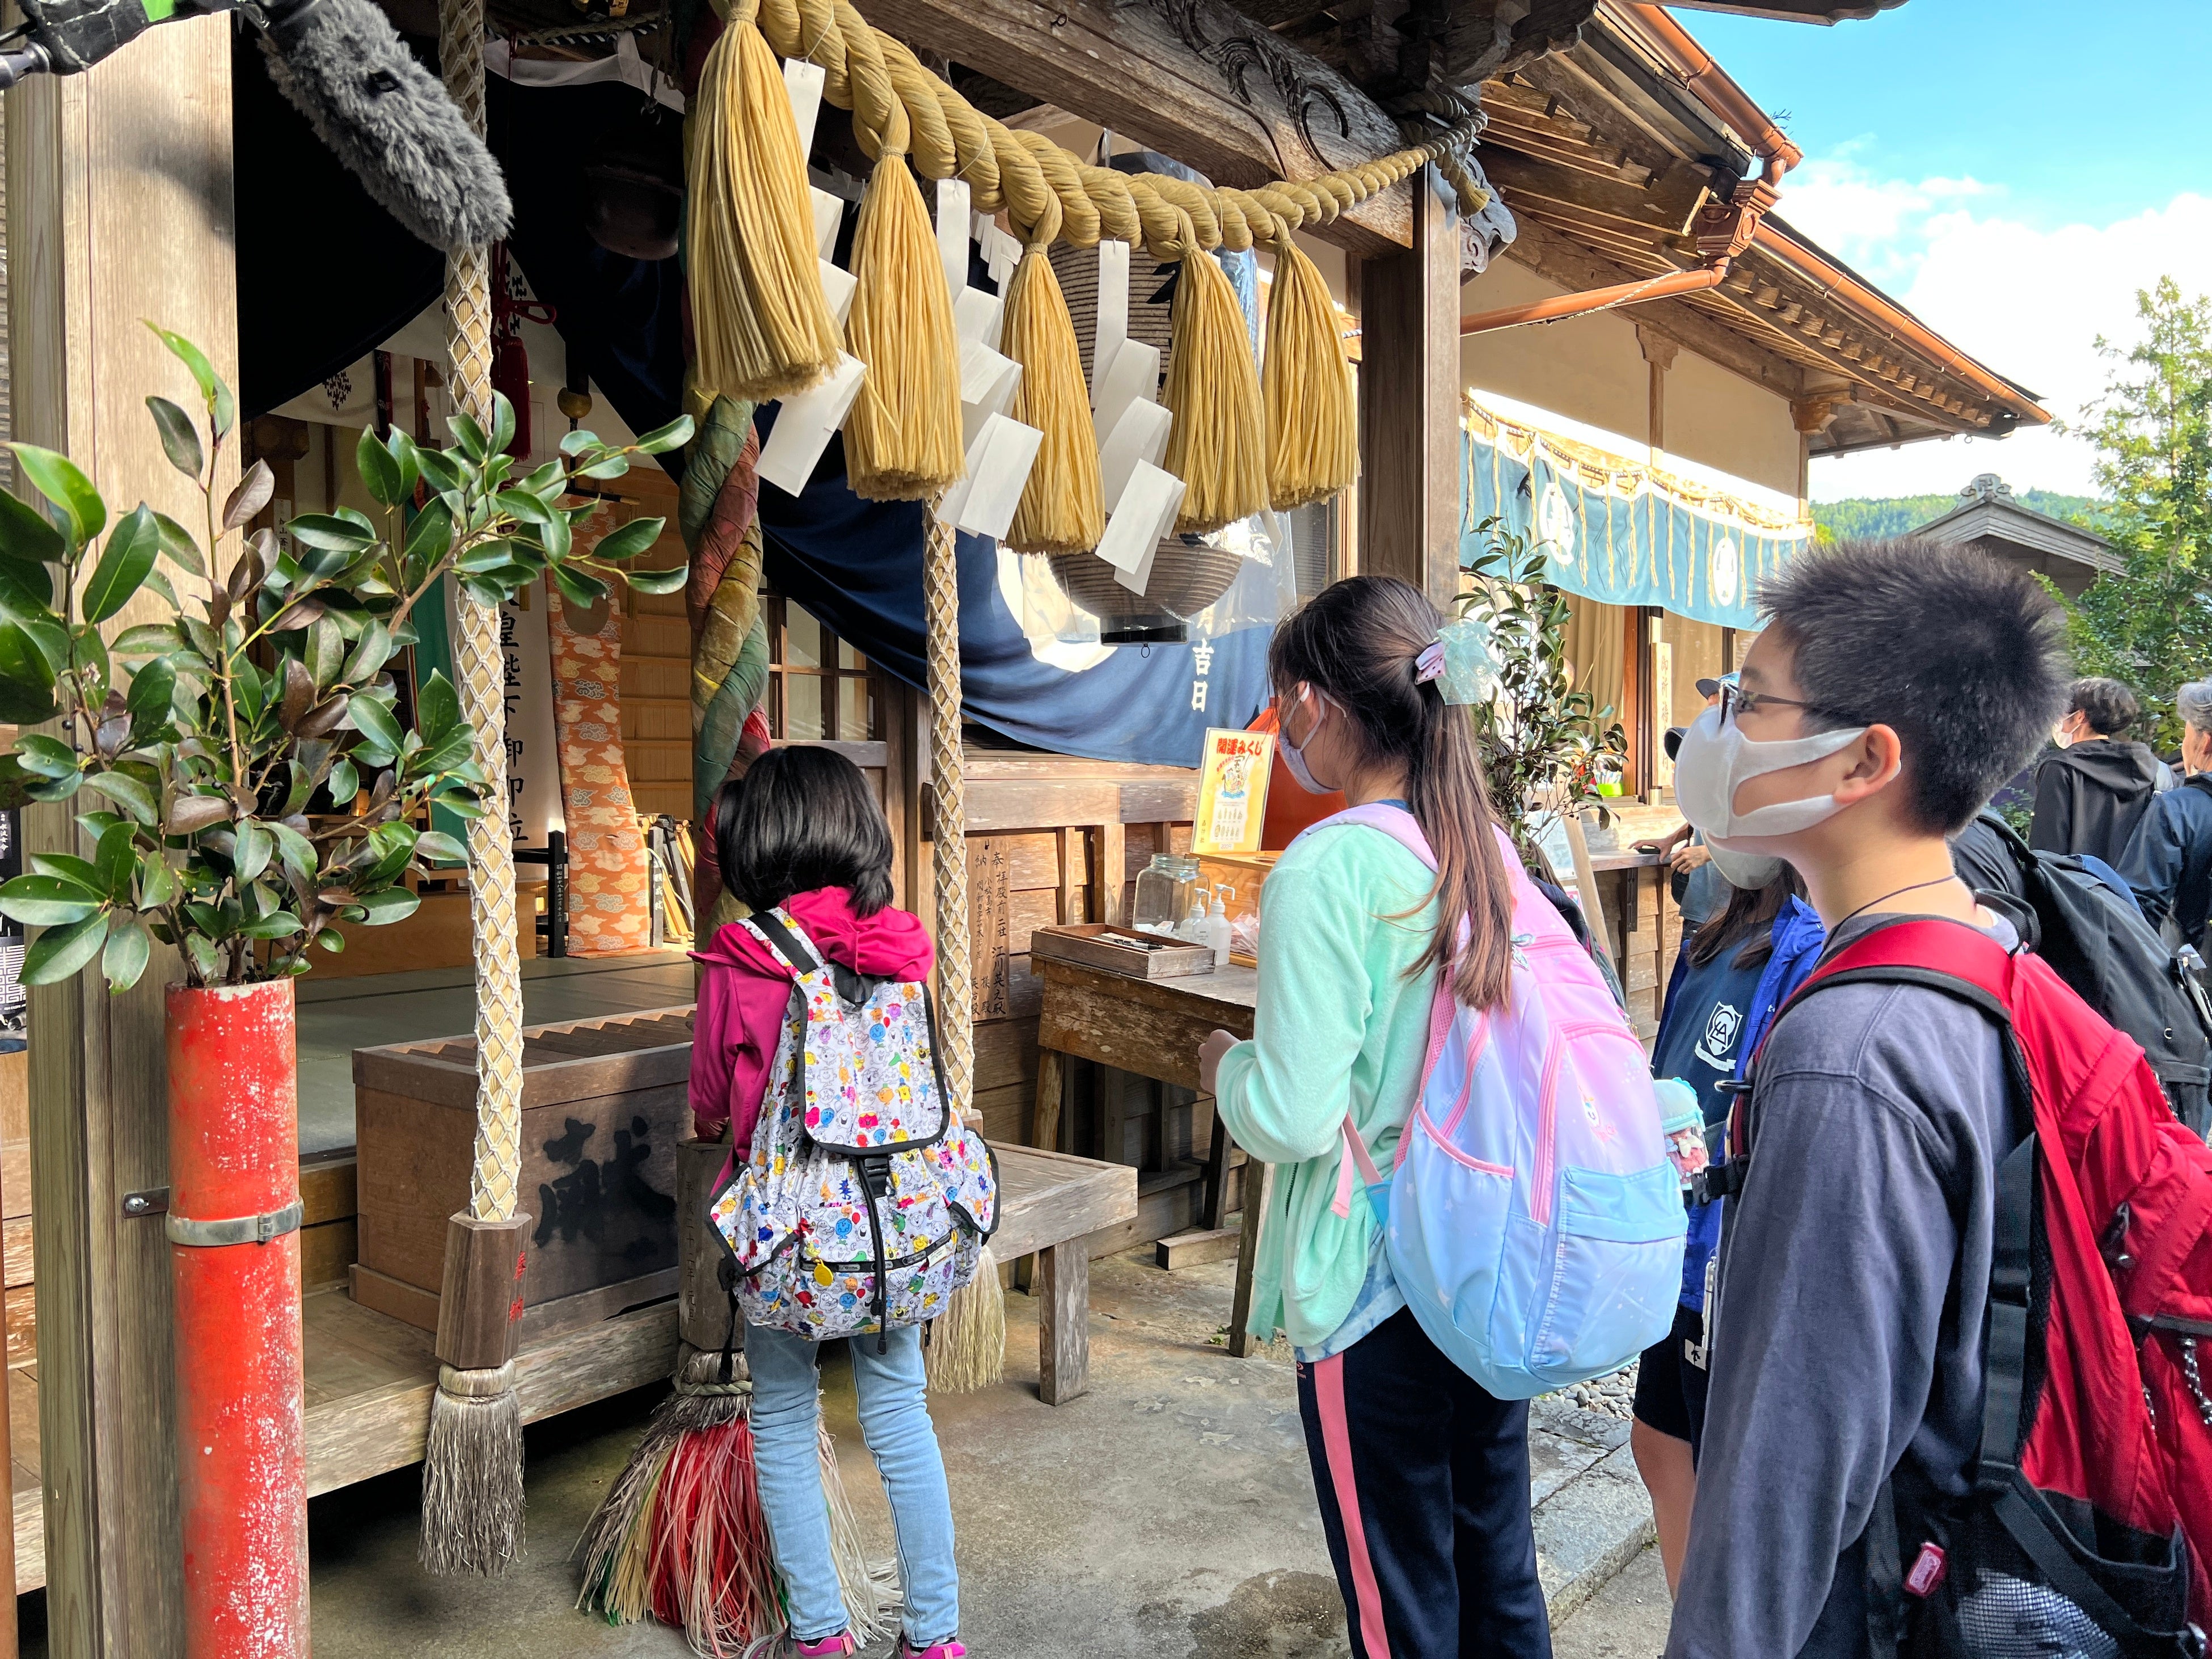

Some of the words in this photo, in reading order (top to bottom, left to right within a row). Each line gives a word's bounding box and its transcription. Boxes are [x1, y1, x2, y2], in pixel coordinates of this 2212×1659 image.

[1216, 738, 1262, 755] 開運みくじ
